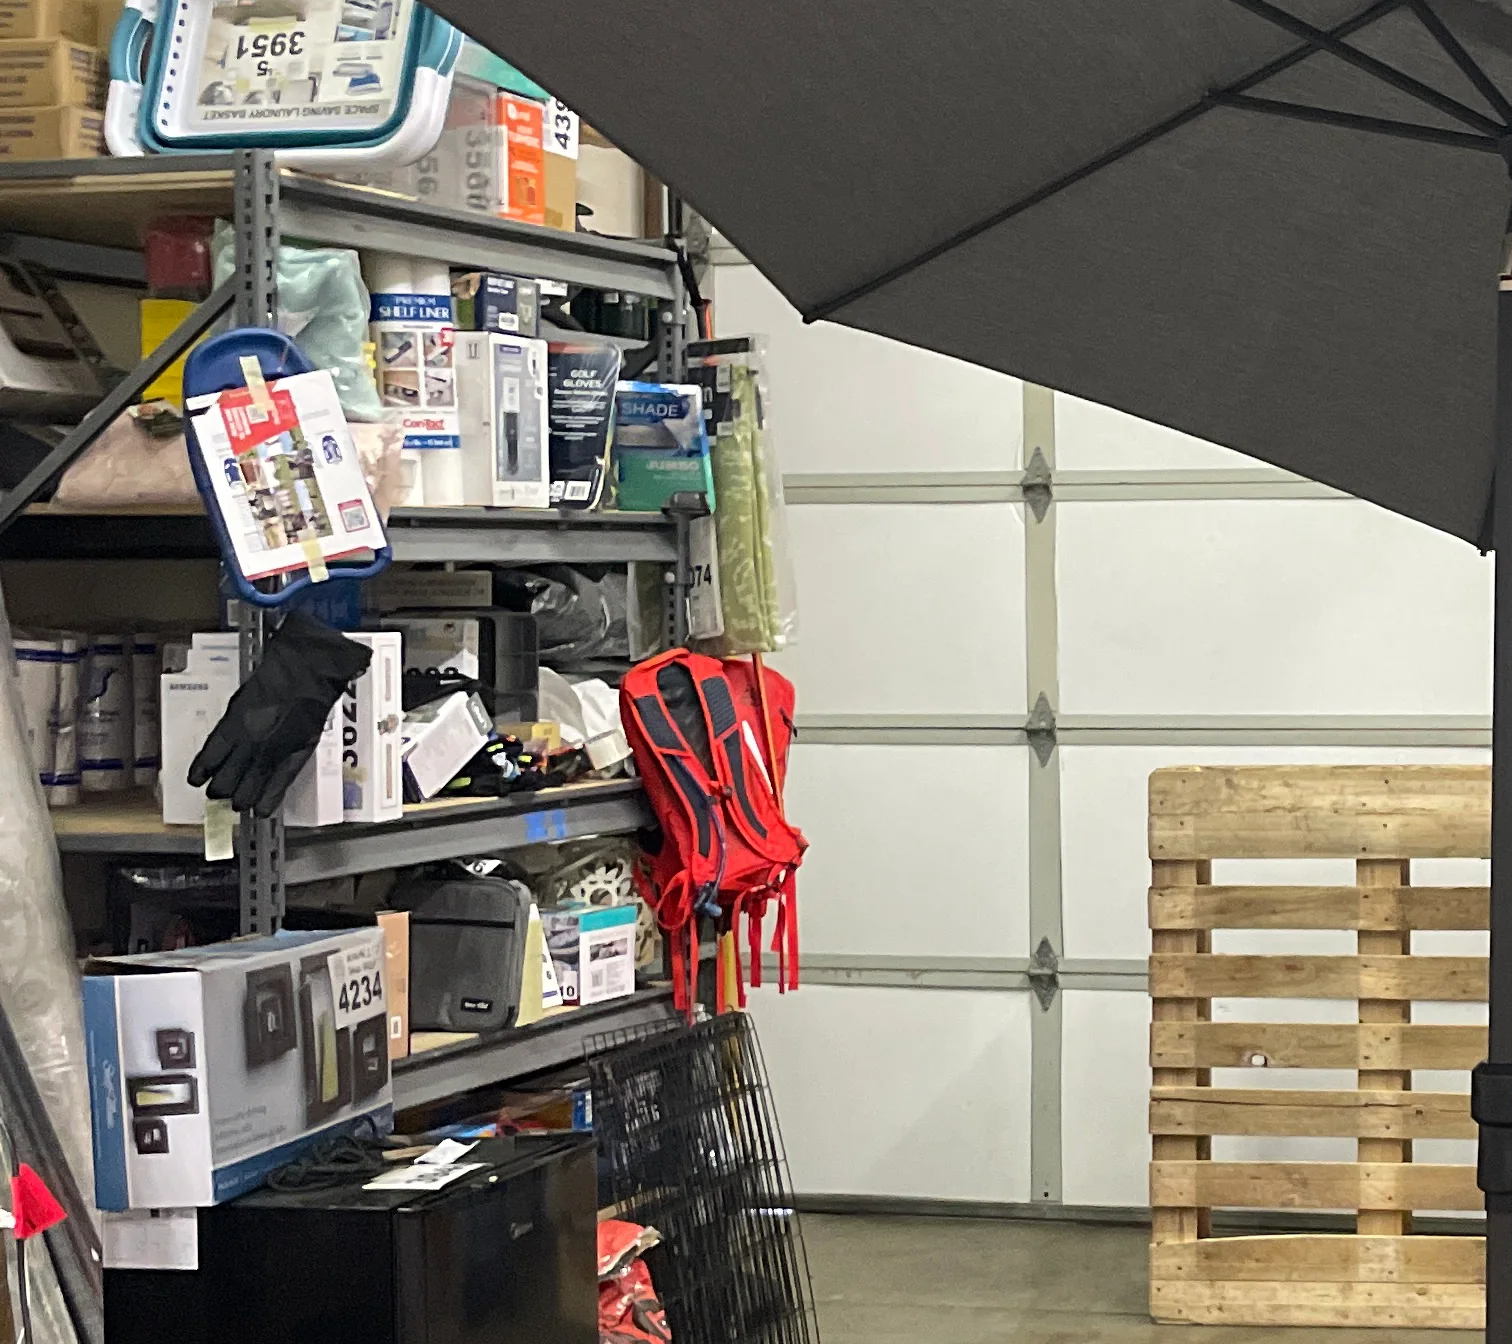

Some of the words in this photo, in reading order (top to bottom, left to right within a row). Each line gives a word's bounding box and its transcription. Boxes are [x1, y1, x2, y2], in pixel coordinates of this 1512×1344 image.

[236, 31, 305, 59] 3951
[203, 109, 246, 120] BASKET
[249, 107, 300, 118] LAUNDRY
[303, 106, 341, 117] SAVING
[379, 307, 417, 318] SHELF
[420, 307, 450, 319] LINER
[570, 369, 598, 379] GOLF
[563, 379, 602, 389] GLOVES
[621, 403, 679, 417] SHADE
[339, 971, 382, 1013] 4234
